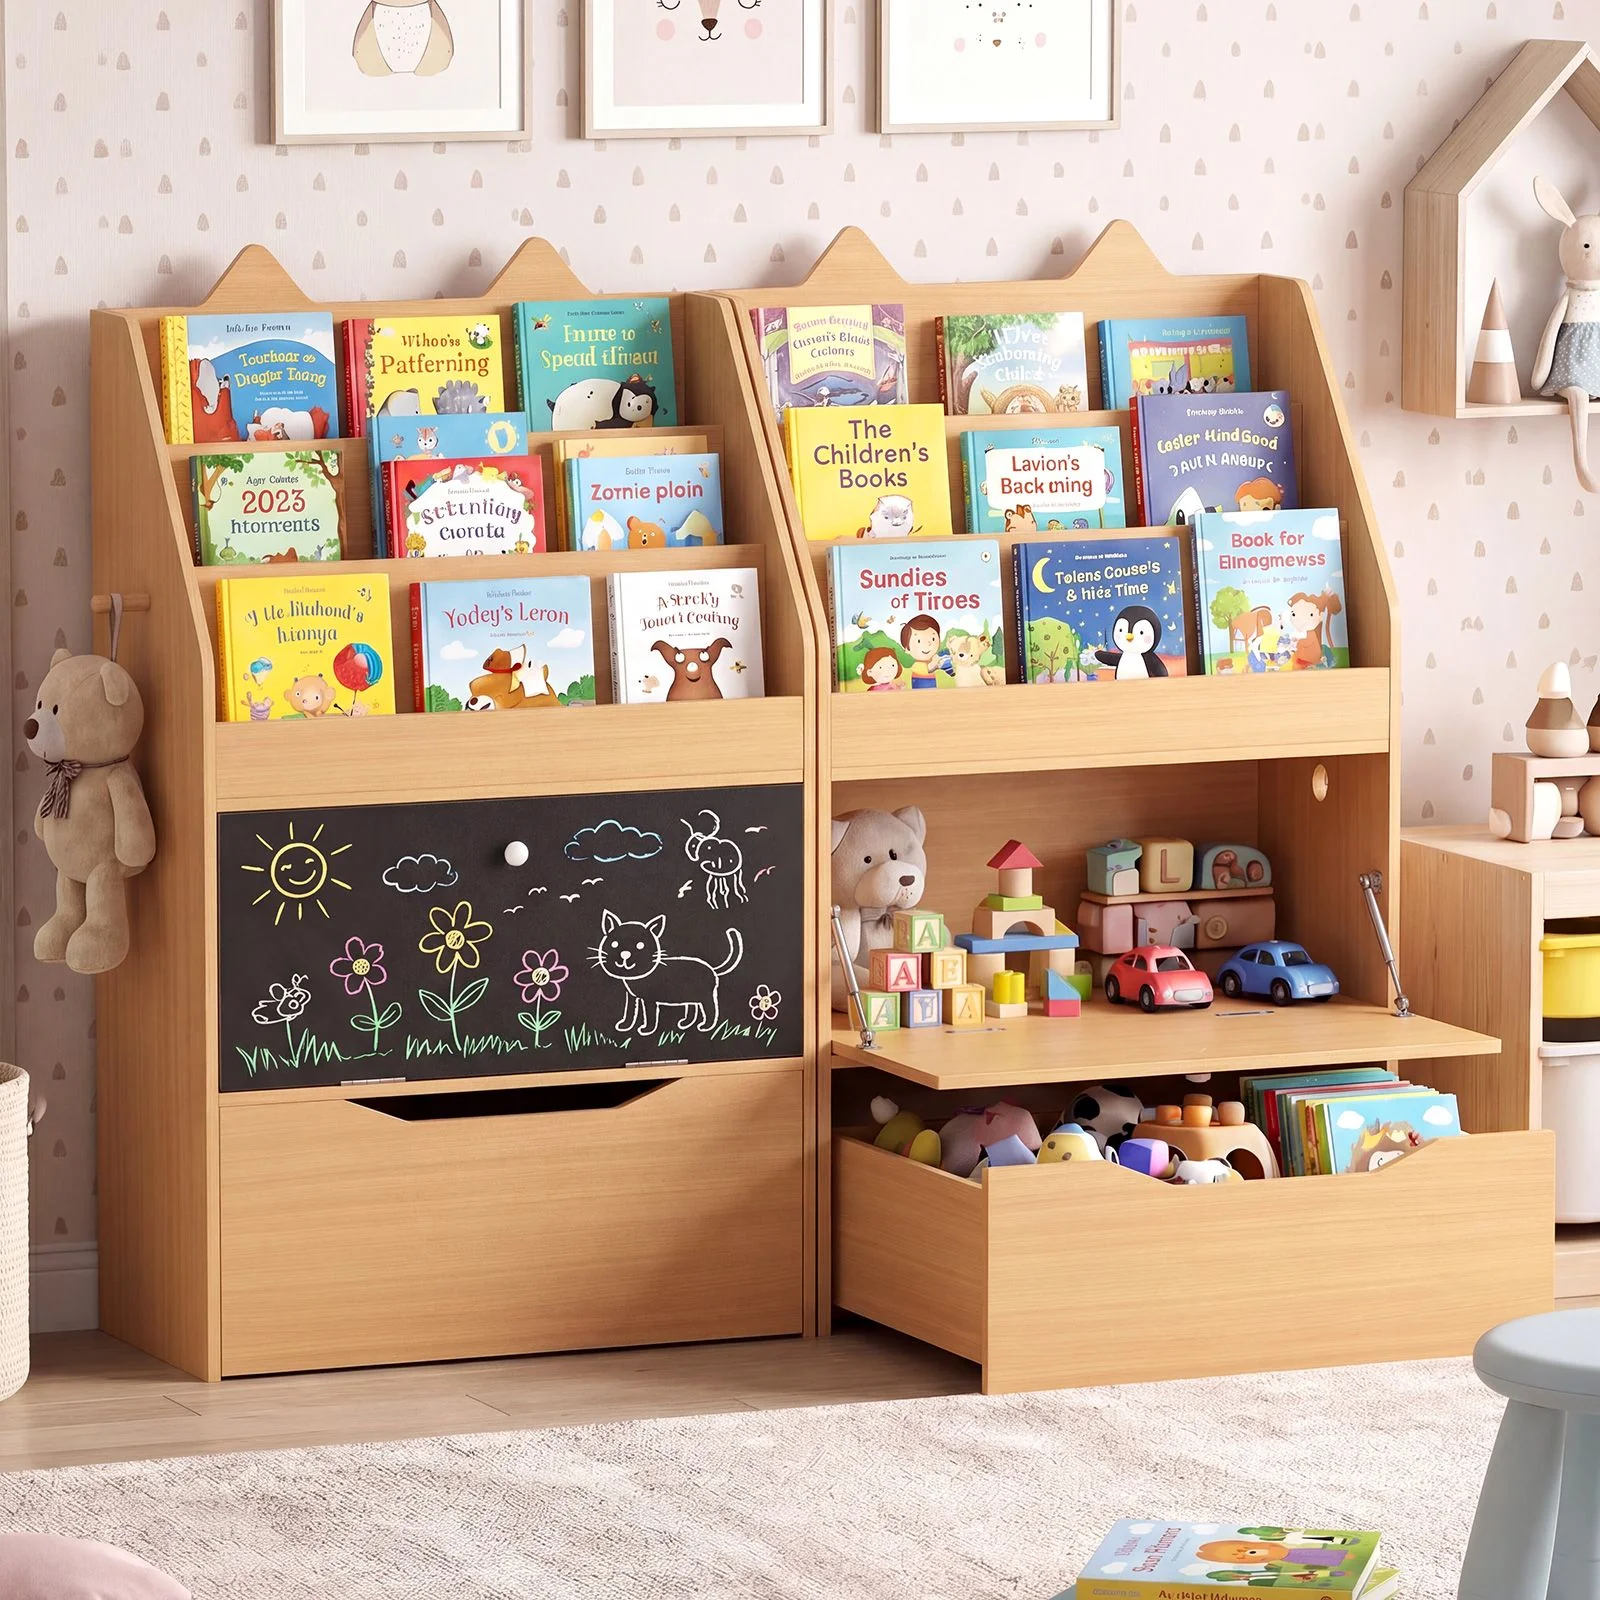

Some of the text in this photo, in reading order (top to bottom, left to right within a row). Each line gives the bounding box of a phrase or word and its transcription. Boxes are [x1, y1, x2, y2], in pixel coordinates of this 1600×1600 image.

[848, 419, 892, 439] The
[813, 442, 929, 465] Children's
[1011, 454, 1080, 472] Lavion's
[839, 468, 908, 489] Books
[1001, 477, 1045, 494] Back
[242, 489, 306, 514] 2023
[656, 480, 703, 504] ploin
[1231, 531, 1305, 548] Book for
[860, 567, 947, 590] Sundies
[1054, 569, 1102, 585] Tolens
[891, 592, 980, 611] of Tiroes
[1066, 588, 1078, 602] &
[1114, 582, 1149, 597] Time
[444, 602, 569, 628] Yodey's Leron
[1160, 848, 1181, 884] L
[917, 921, 938, 947] A
[892, 960, 916, 987] A
[941, 959, 959, 981] E
[872, 998, 894, 1026] A
[958, 993, 979, 1019] A
